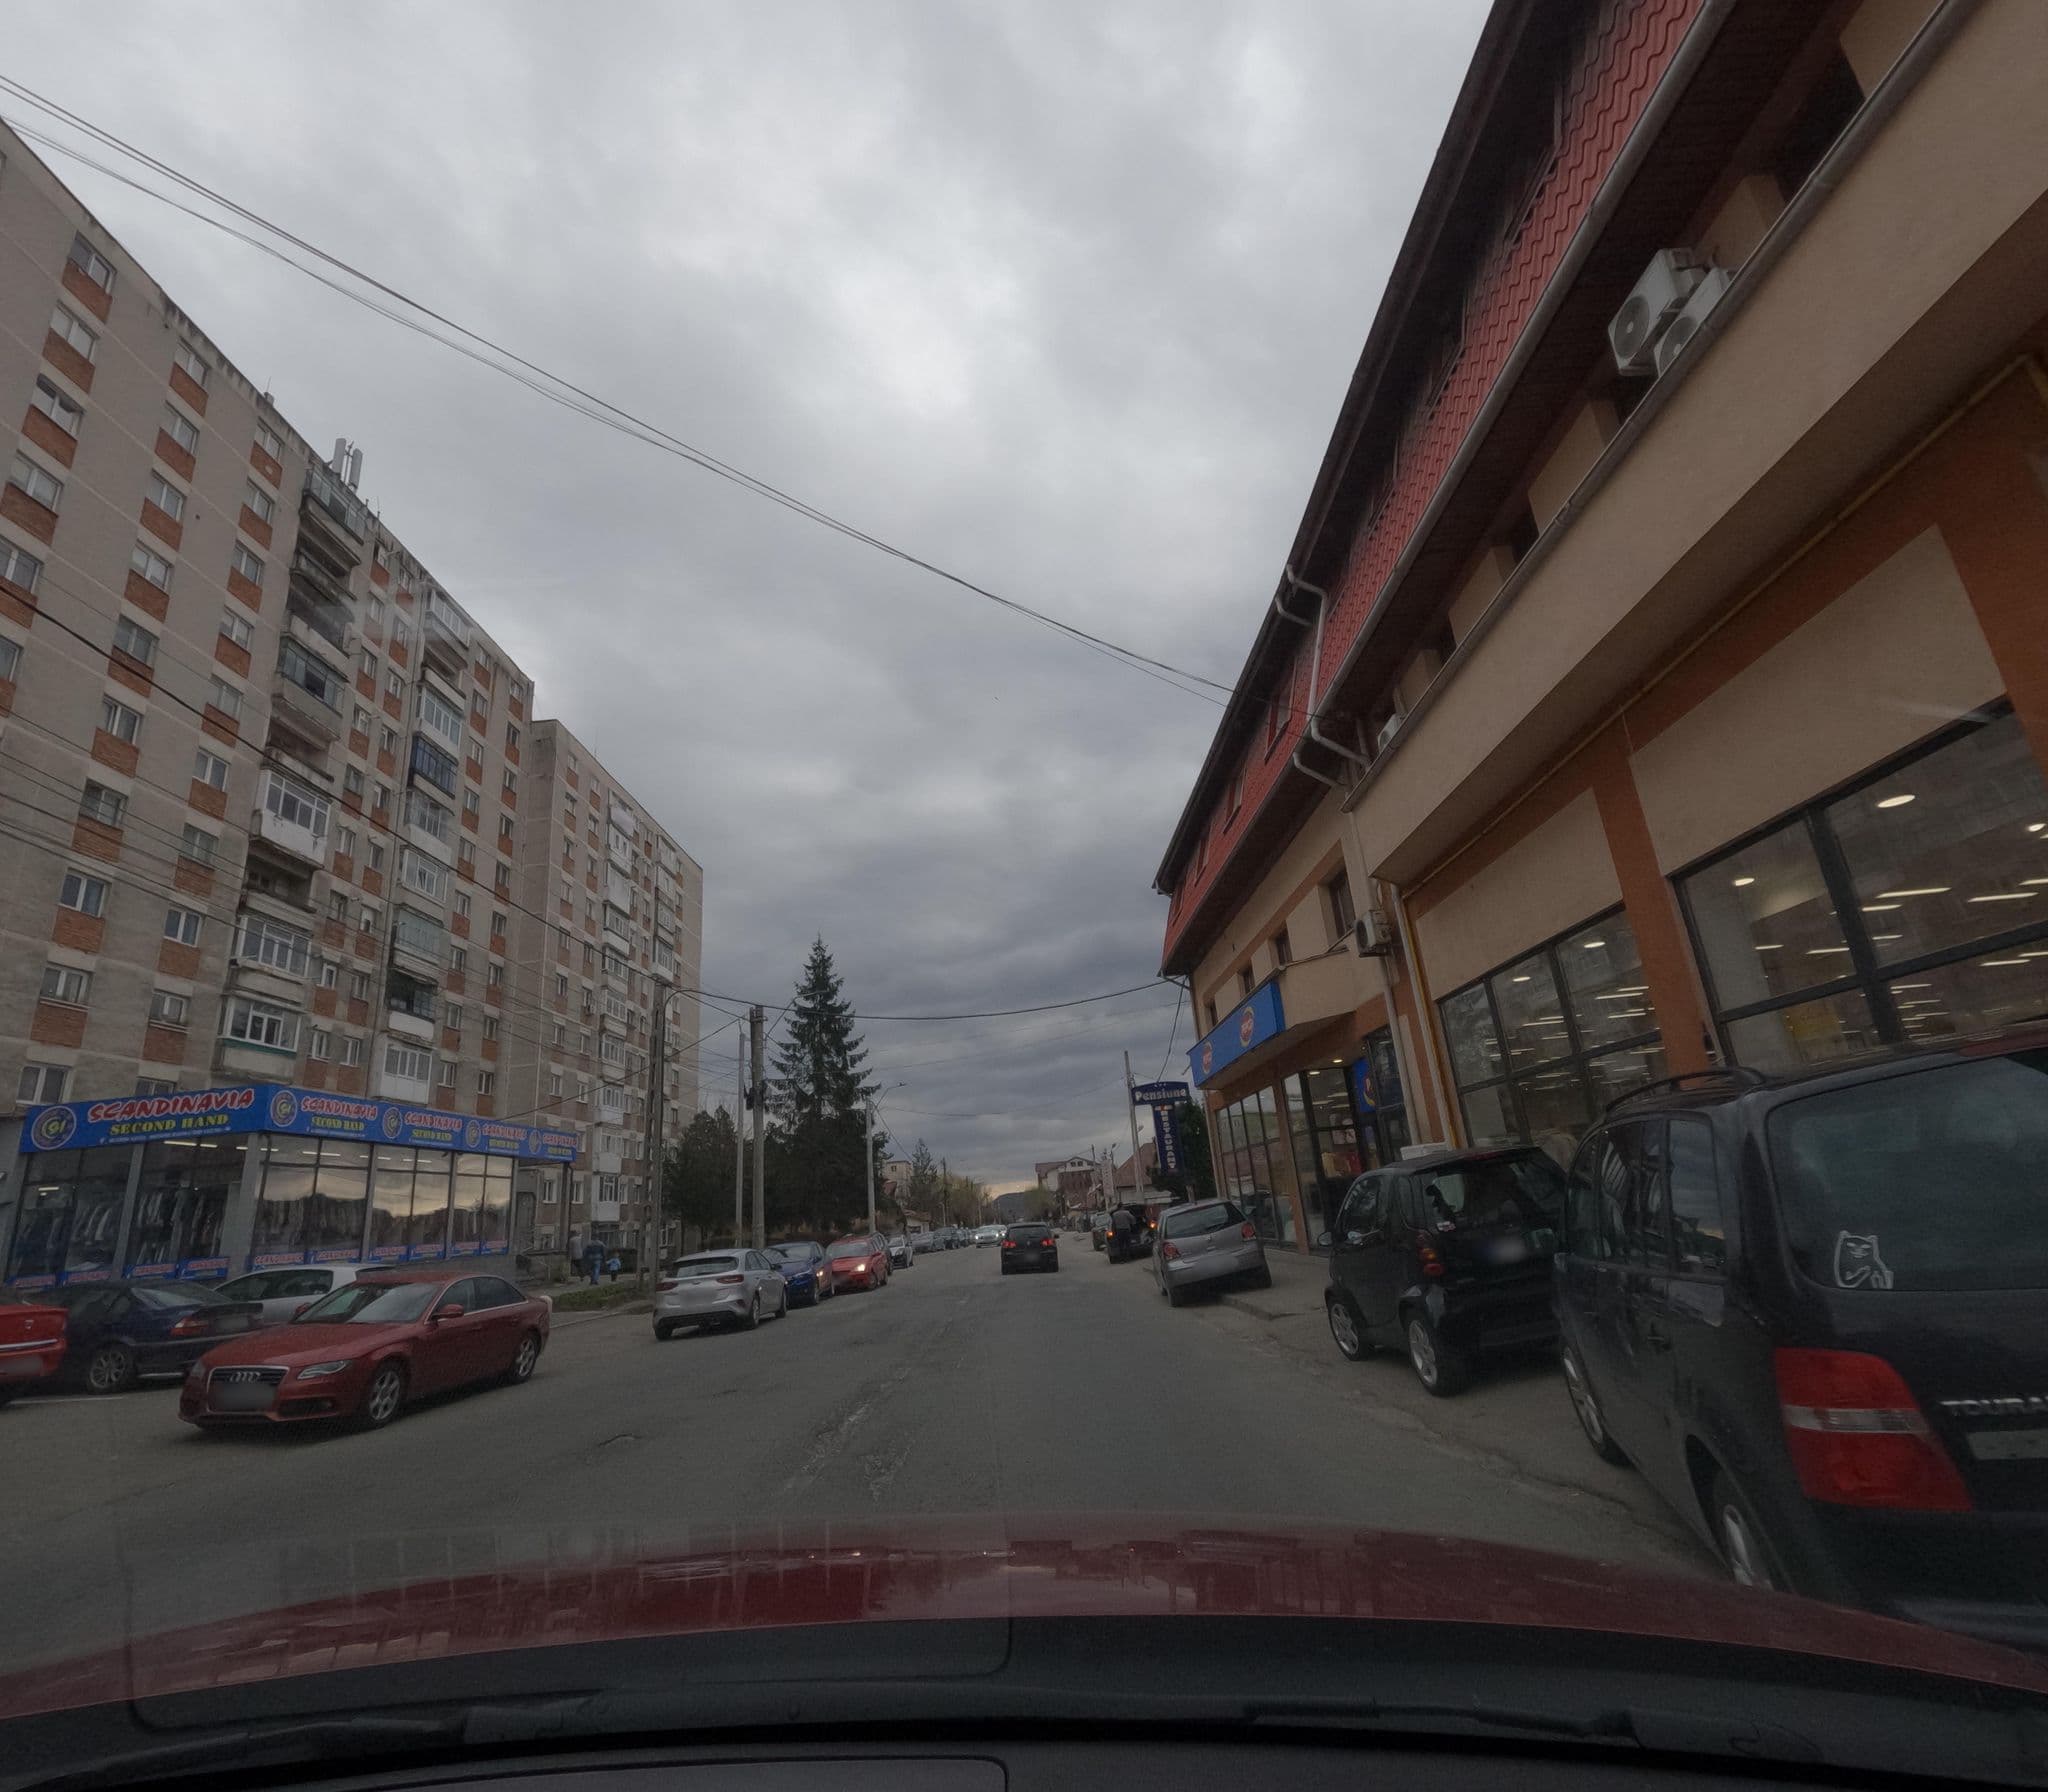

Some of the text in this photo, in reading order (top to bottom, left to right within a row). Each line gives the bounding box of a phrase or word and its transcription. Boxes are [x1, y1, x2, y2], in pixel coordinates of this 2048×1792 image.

[88, 1088, 254, 1123] SCANDINAVIA
[1135, 1088, 1186, 1101] Pensiune
[301, 1096, 378, 1120] SCANDINAVIA
[110, 1120, 175, 1136] SECOND
[181, 1114, 229, 1130] HAND
[312, 1116, 342, 1129] SECOND
[404, 1111, 463, 1131] SCANDINAVIA
[1160, 1110, 1176, 1169] RESTAURANT
